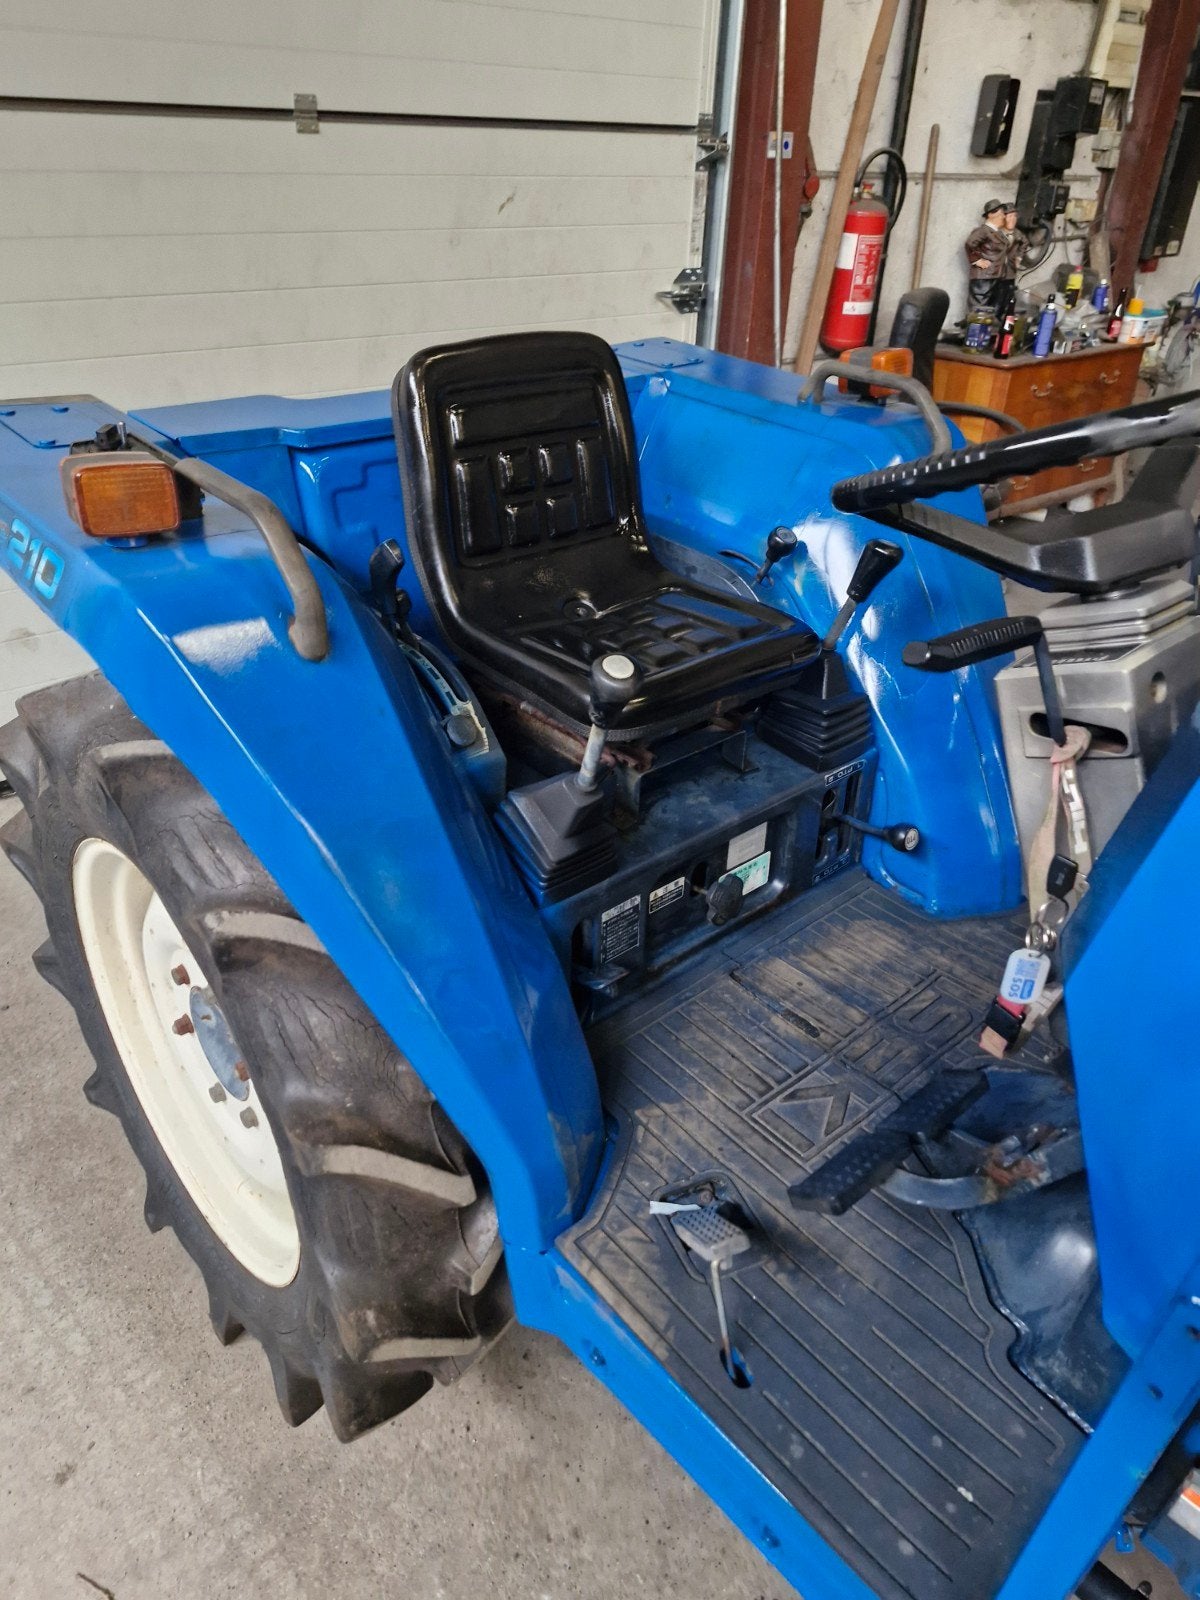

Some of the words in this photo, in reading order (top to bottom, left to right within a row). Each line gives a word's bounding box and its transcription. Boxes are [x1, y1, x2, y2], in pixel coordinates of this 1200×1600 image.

[7, 519, 65, 599] 210
[837, 766, 854, 778] PTO
[1008, 977, 1022, 998] SOS
